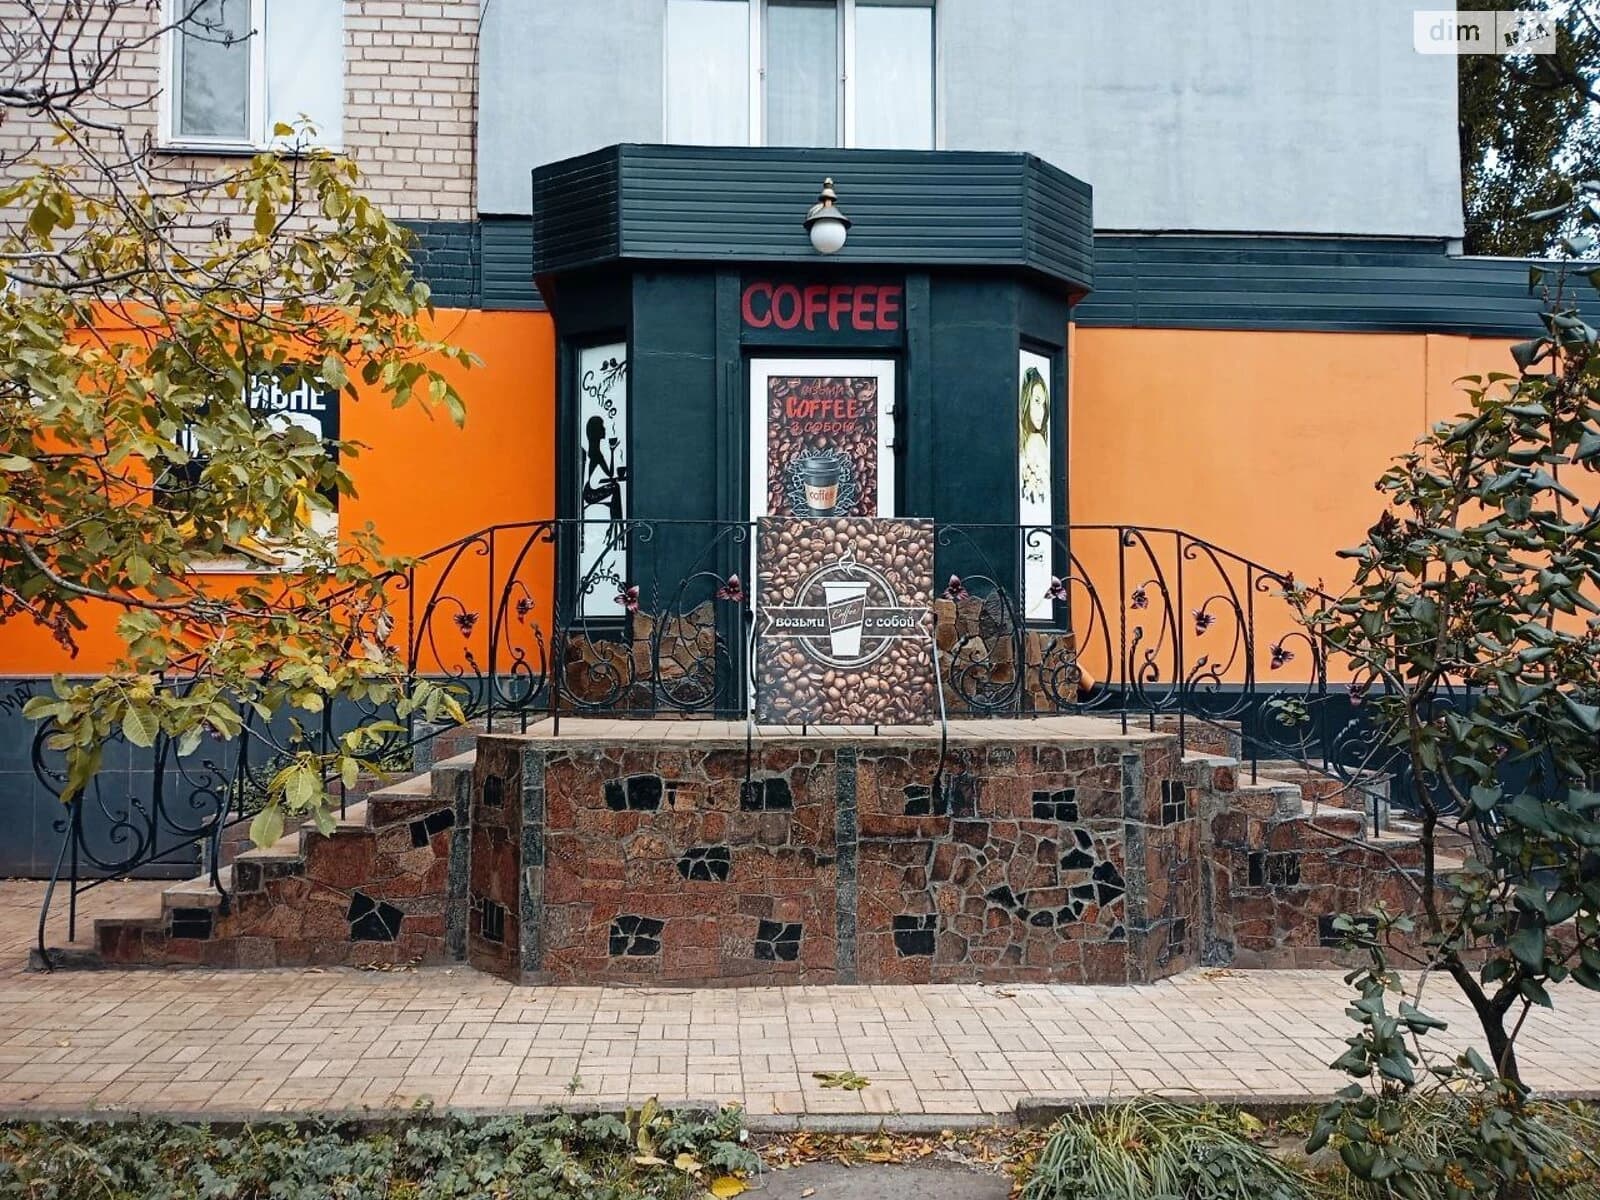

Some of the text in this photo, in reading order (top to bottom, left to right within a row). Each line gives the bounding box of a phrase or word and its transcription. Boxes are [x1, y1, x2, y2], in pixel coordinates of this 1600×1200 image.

[742, 282, 902, 331] COFFEE
[582, 370, 617, 420] Coffee
[785, 394, 857, 419] COFFEE
[775, 618, 825, 628] возьми
[876, 615, 915, 628] собой
